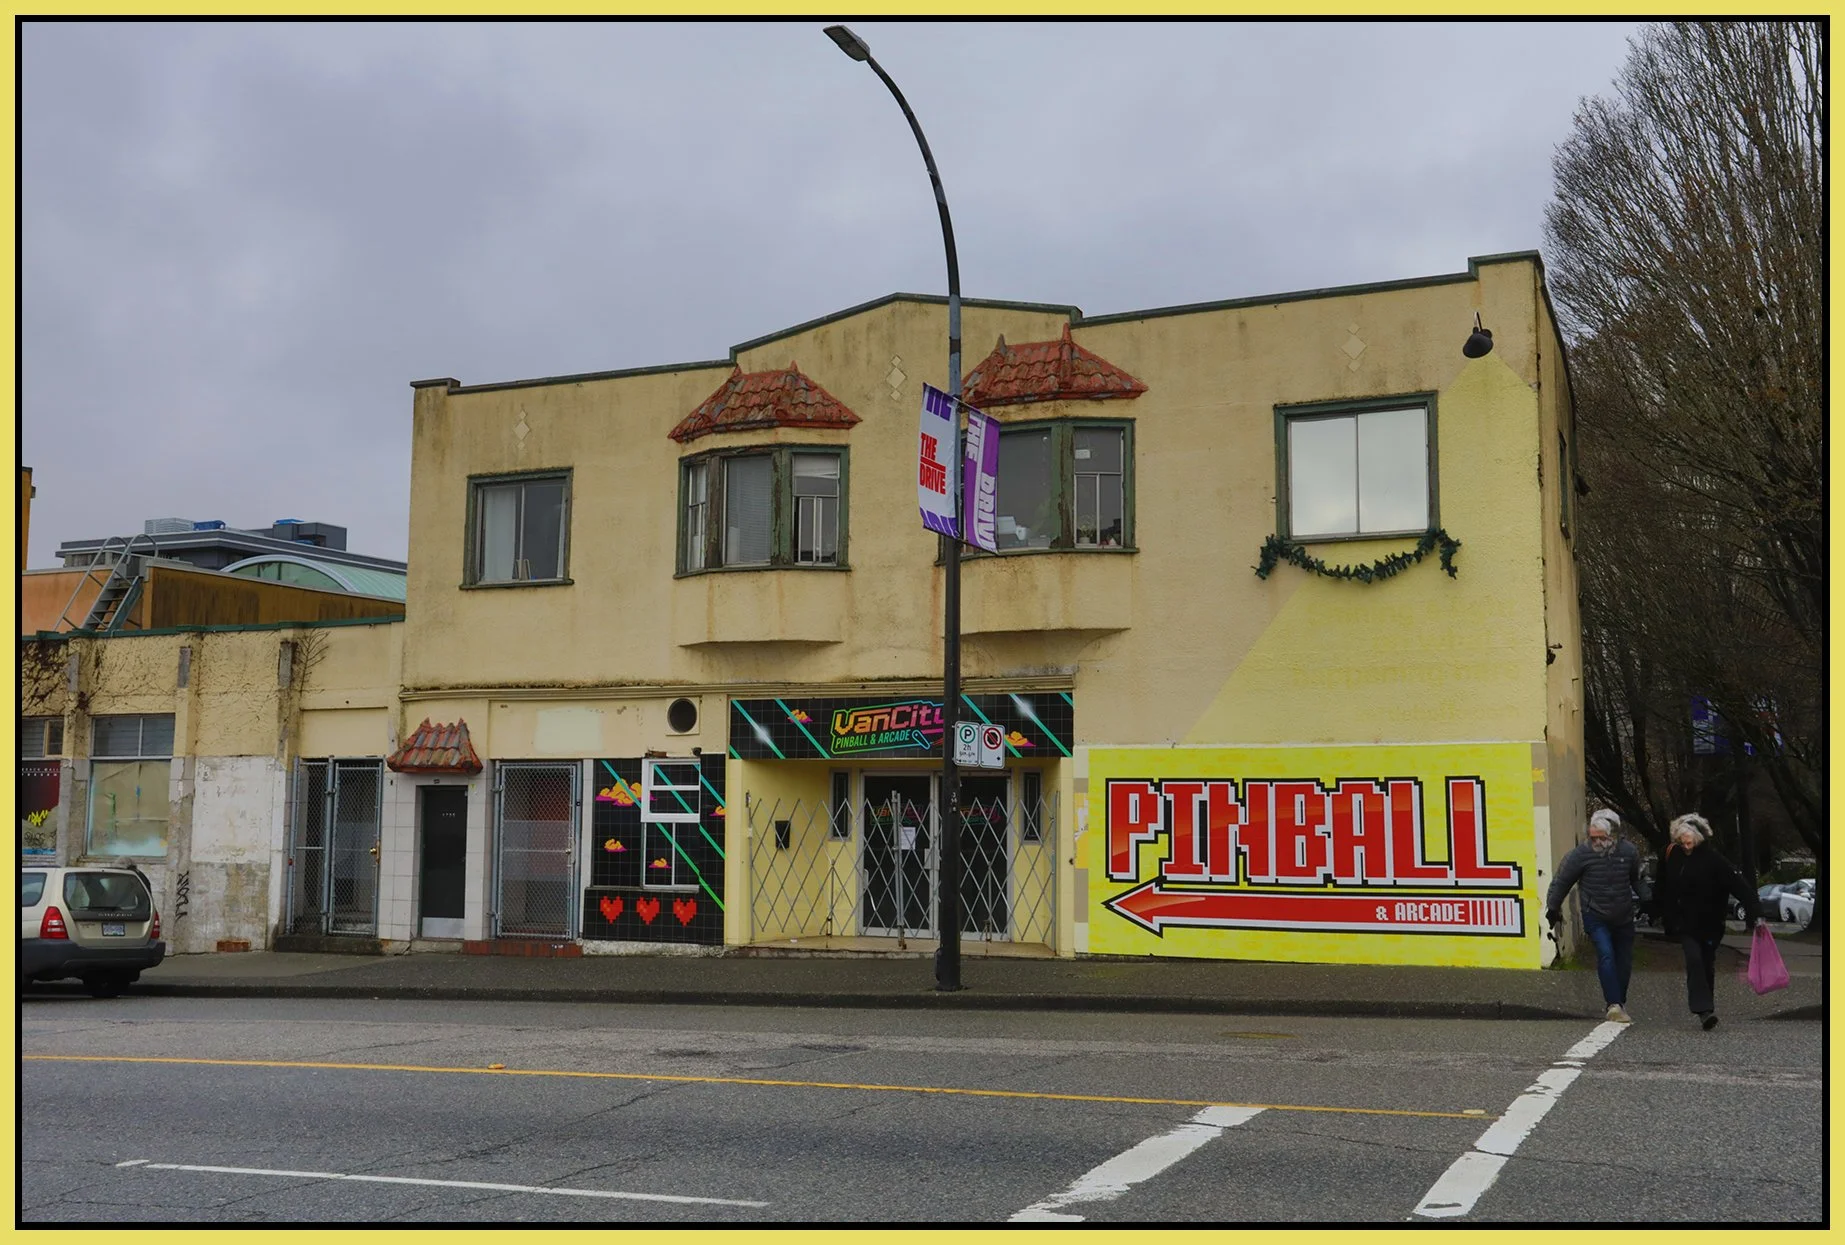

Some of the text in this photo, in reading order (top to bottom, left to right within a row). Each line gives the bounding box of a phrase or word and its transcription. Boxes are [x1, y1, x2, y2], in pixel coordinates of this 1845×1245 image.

[920, 433, 937, 461] THE
[920, 464, 946, 495] DRIVE
[836, 735, 867, 748] PINBALL
[878, 730, 911, 744] ARCADE
[964, 729, 972, 739] P
[1105, 776, 1523, 889] PINBALL
[1375, 902, 1466, 922] & ARCADE
